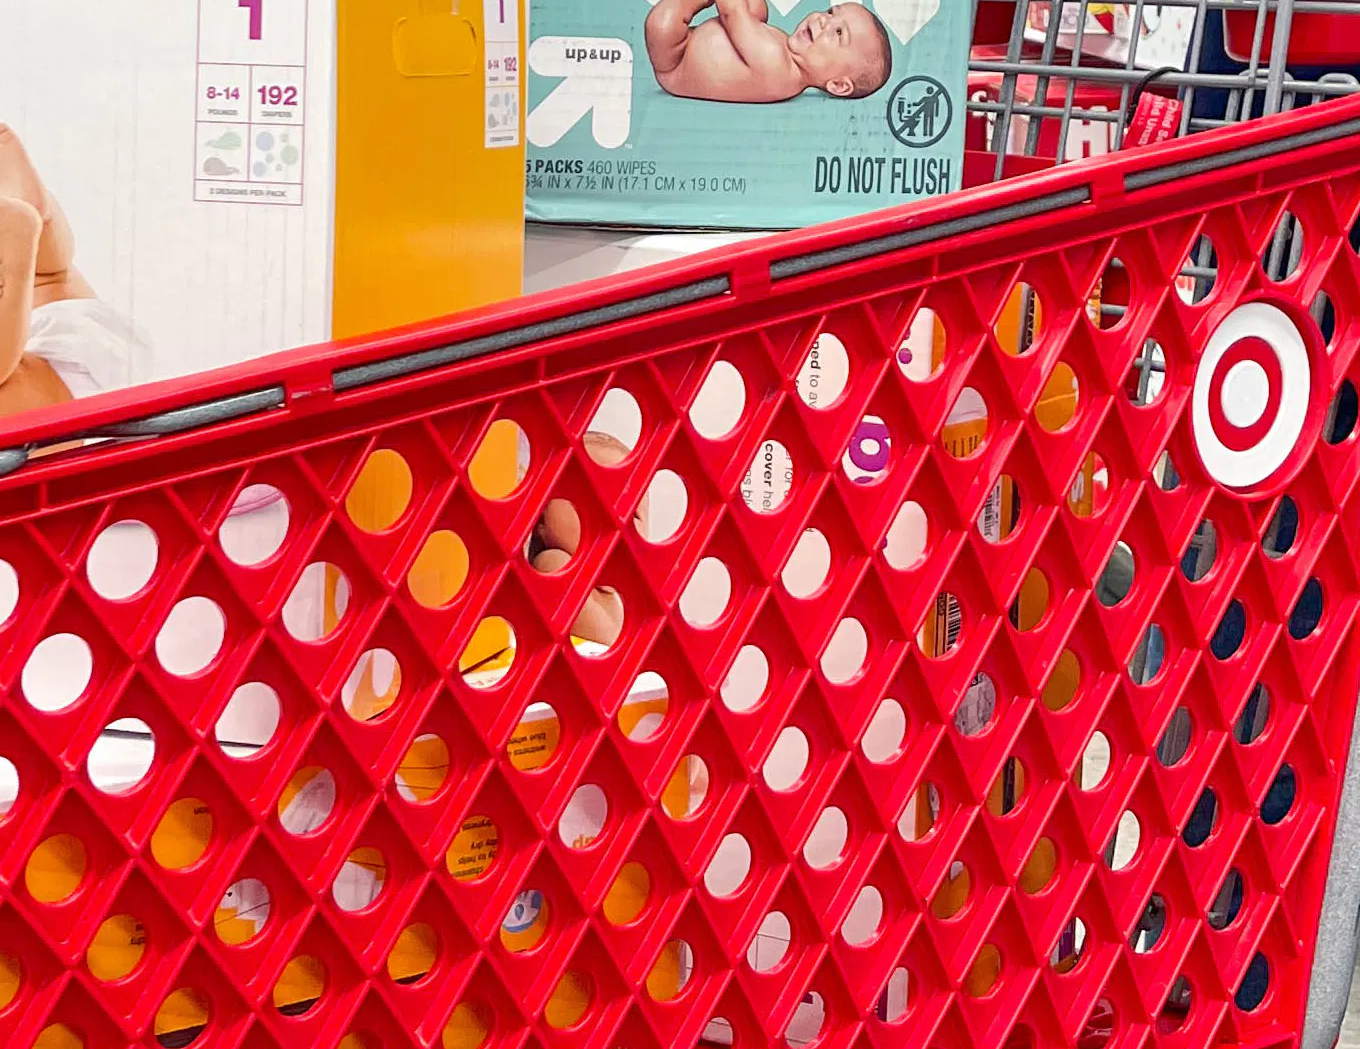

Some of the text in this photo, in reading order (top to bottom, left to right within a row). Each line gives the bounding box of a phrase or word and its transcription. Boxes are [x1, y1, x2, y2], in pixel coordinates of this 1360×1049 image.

[565, 47, 622, 64] up&up
[206, 86, 240, 101] 8-14
[257, 85, 298, 106] 192
[535, 159, 584, 175] PACKS
[587, 160, 614, 175] 460
[616, 160, 657, 176] WIPES
[814, 156, 952, 196] DO NOT FLUSH
